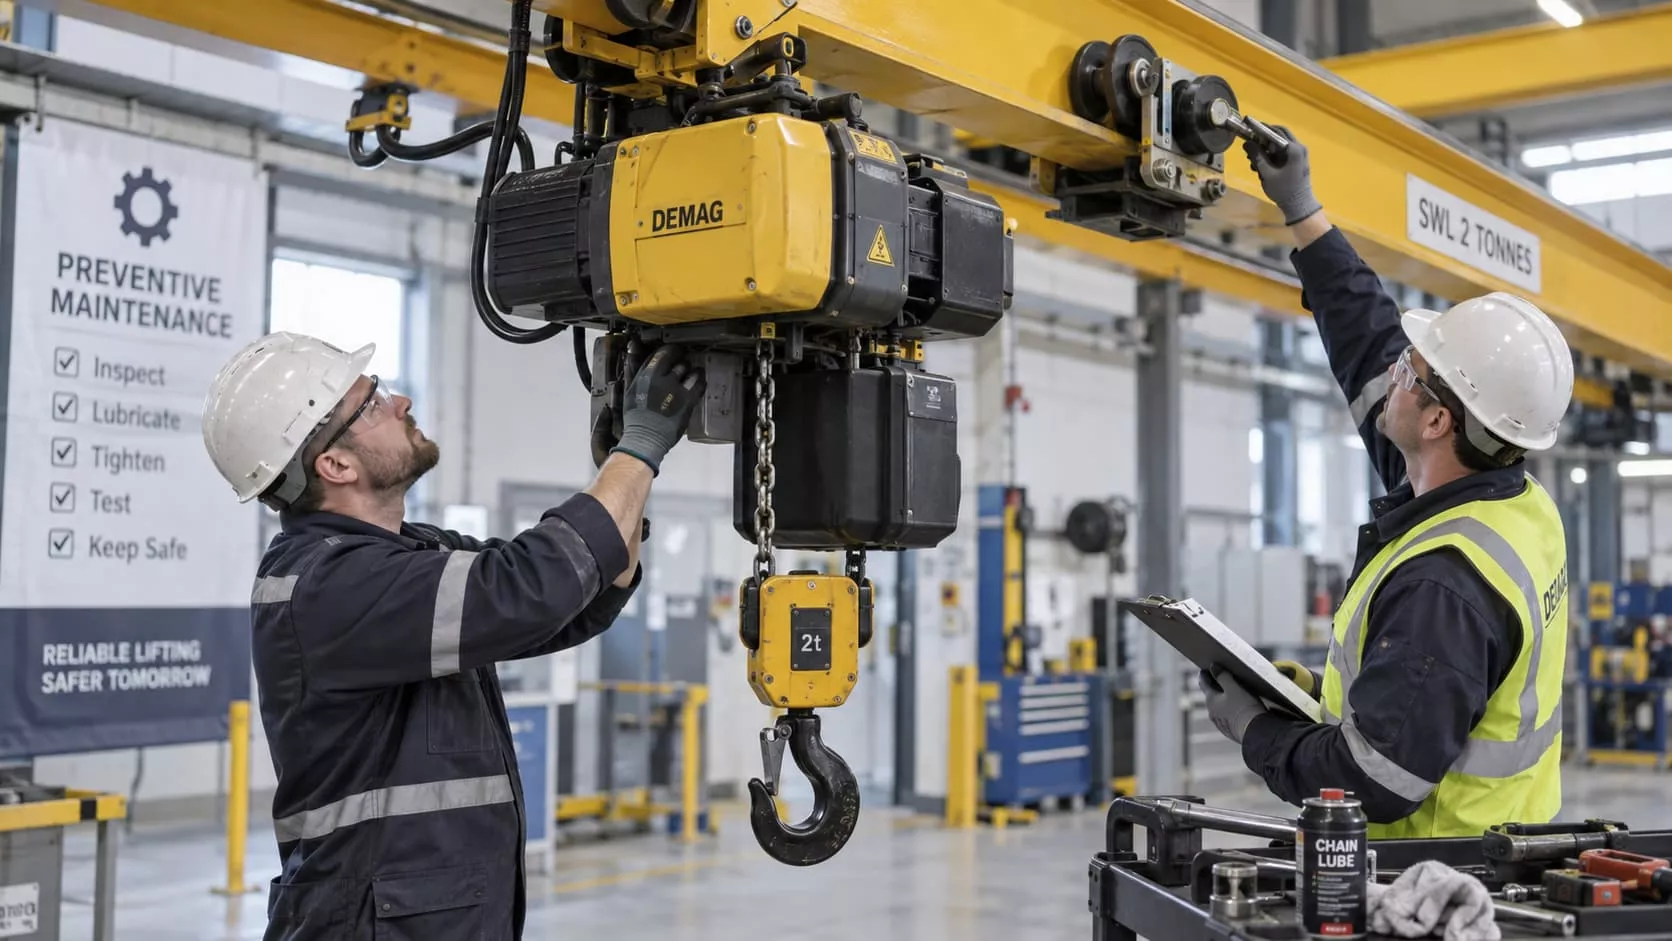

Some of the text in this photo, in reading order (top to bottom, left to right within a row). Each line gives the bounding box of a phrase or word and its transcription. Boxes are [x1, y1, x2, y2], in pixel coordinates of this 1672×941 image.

[652, 200, 724, 233] DEMAG
[1419, 197, 1533, 276] SWL 2 TONNES
[57, 252, 222, 303] PREVENTIVE
[51, 288, 233, 339] MAINTENANCE
[94, 356, 166, 386] Inspect
[92, 400, 181, 430] Lubricate
[91, 445, 166, 475] Tighten
[90, 489, 131, 514] Test
[88, 535, 188, 564] Keep Safe
[43, 640, 201, 666] RELIABLE LIFTING
[801, 633, 822, 652] 2t
[41, 665, 211, 694] SAFER TOMORROW
[1315, 838, 1358, 853] CHAIN
[1317, 854, 1355, 868] LUBE
